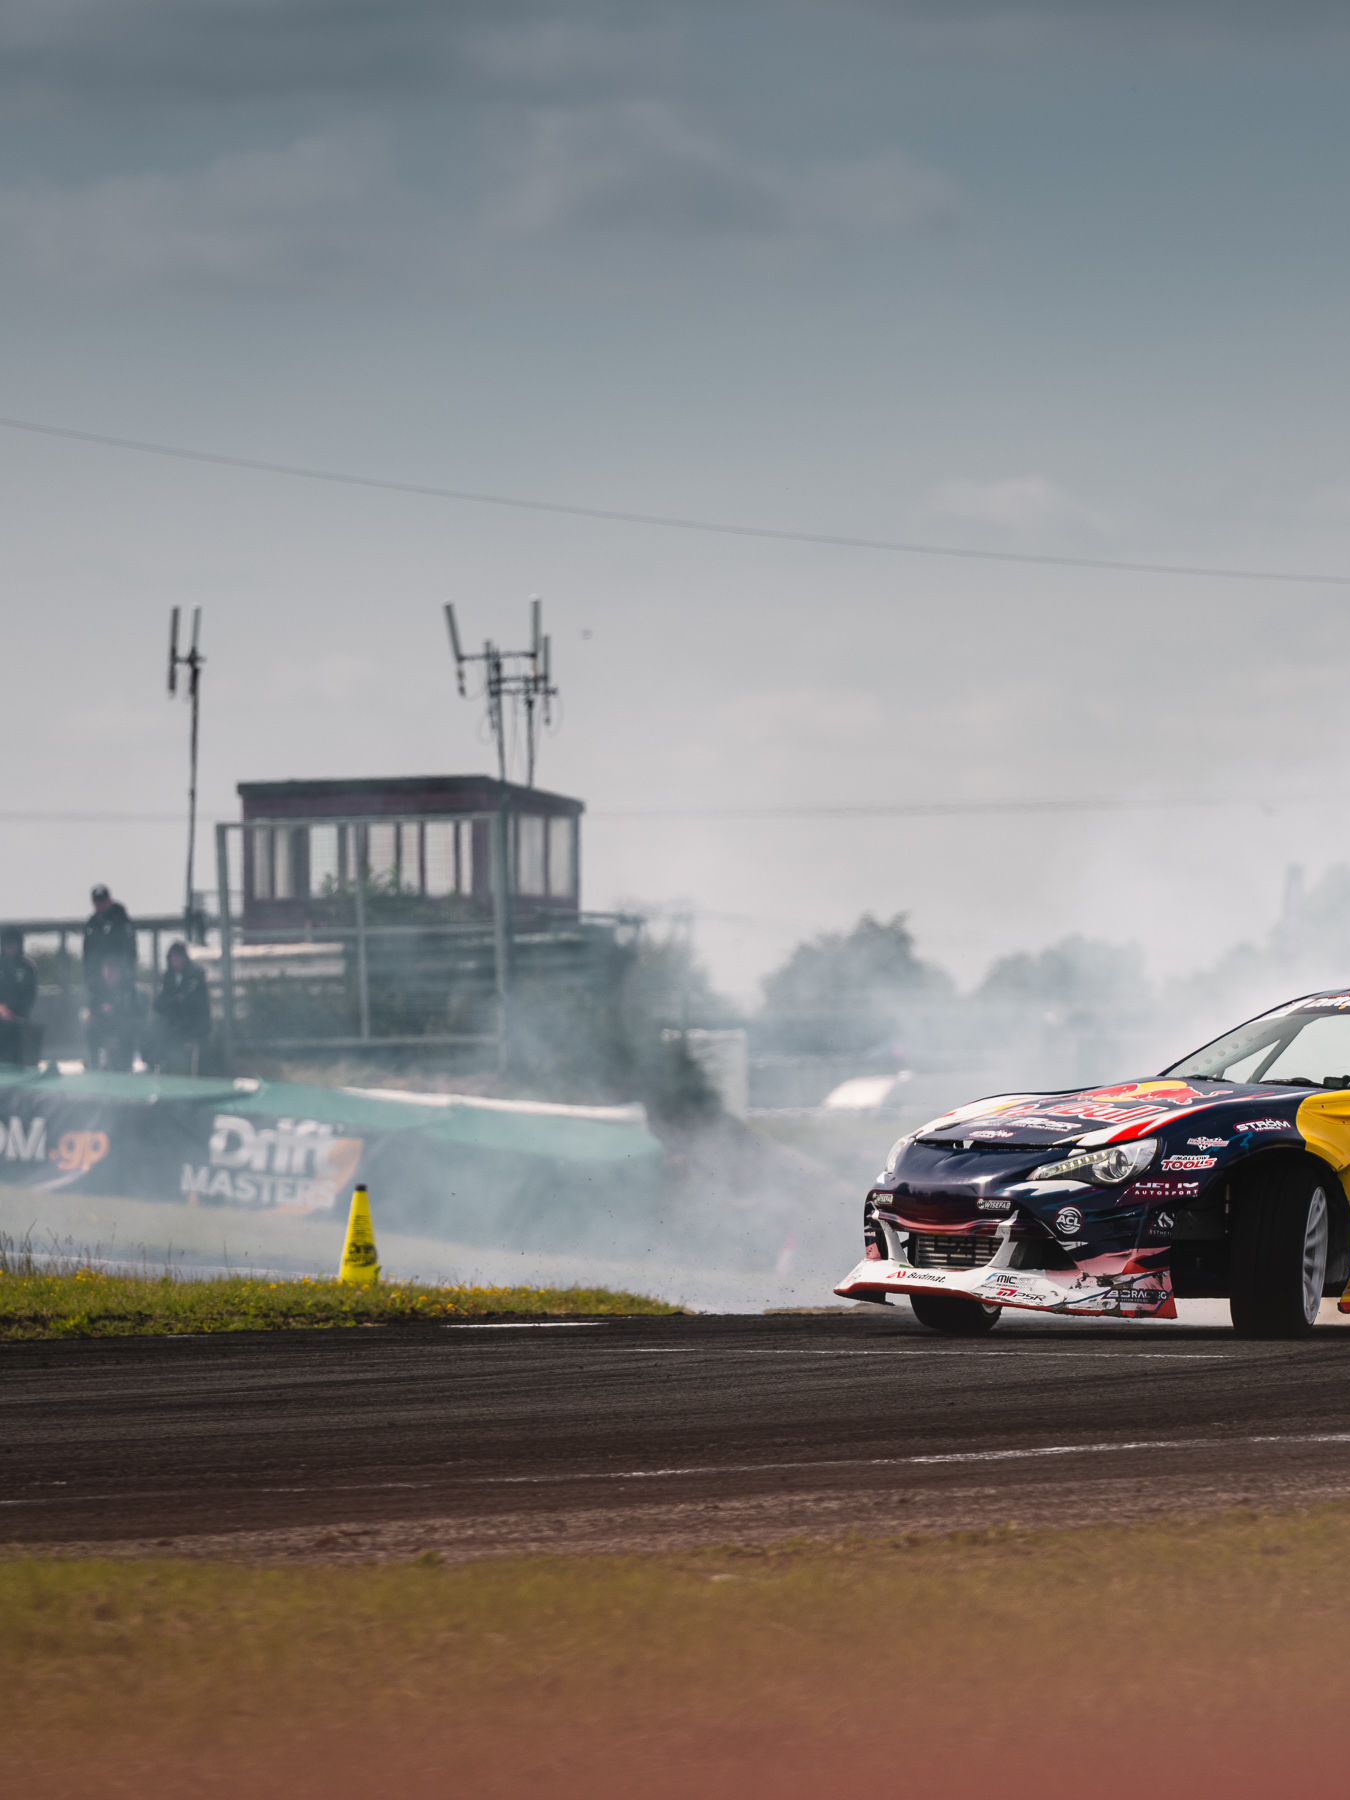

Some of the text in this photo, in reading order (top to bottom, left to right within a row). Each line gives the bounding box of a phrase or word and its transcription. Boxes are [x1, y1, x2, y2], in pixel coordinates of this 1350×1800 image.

[1236, 1119, 1291, 1131] STRÖM
[209, 1114, 338, 1174] Drift
[1162, 1159, 1215, 1170] TOOLS
[181, 1163, 336, 1209] MASTERS
[1056, 1215, 1081, 1227] ACL
